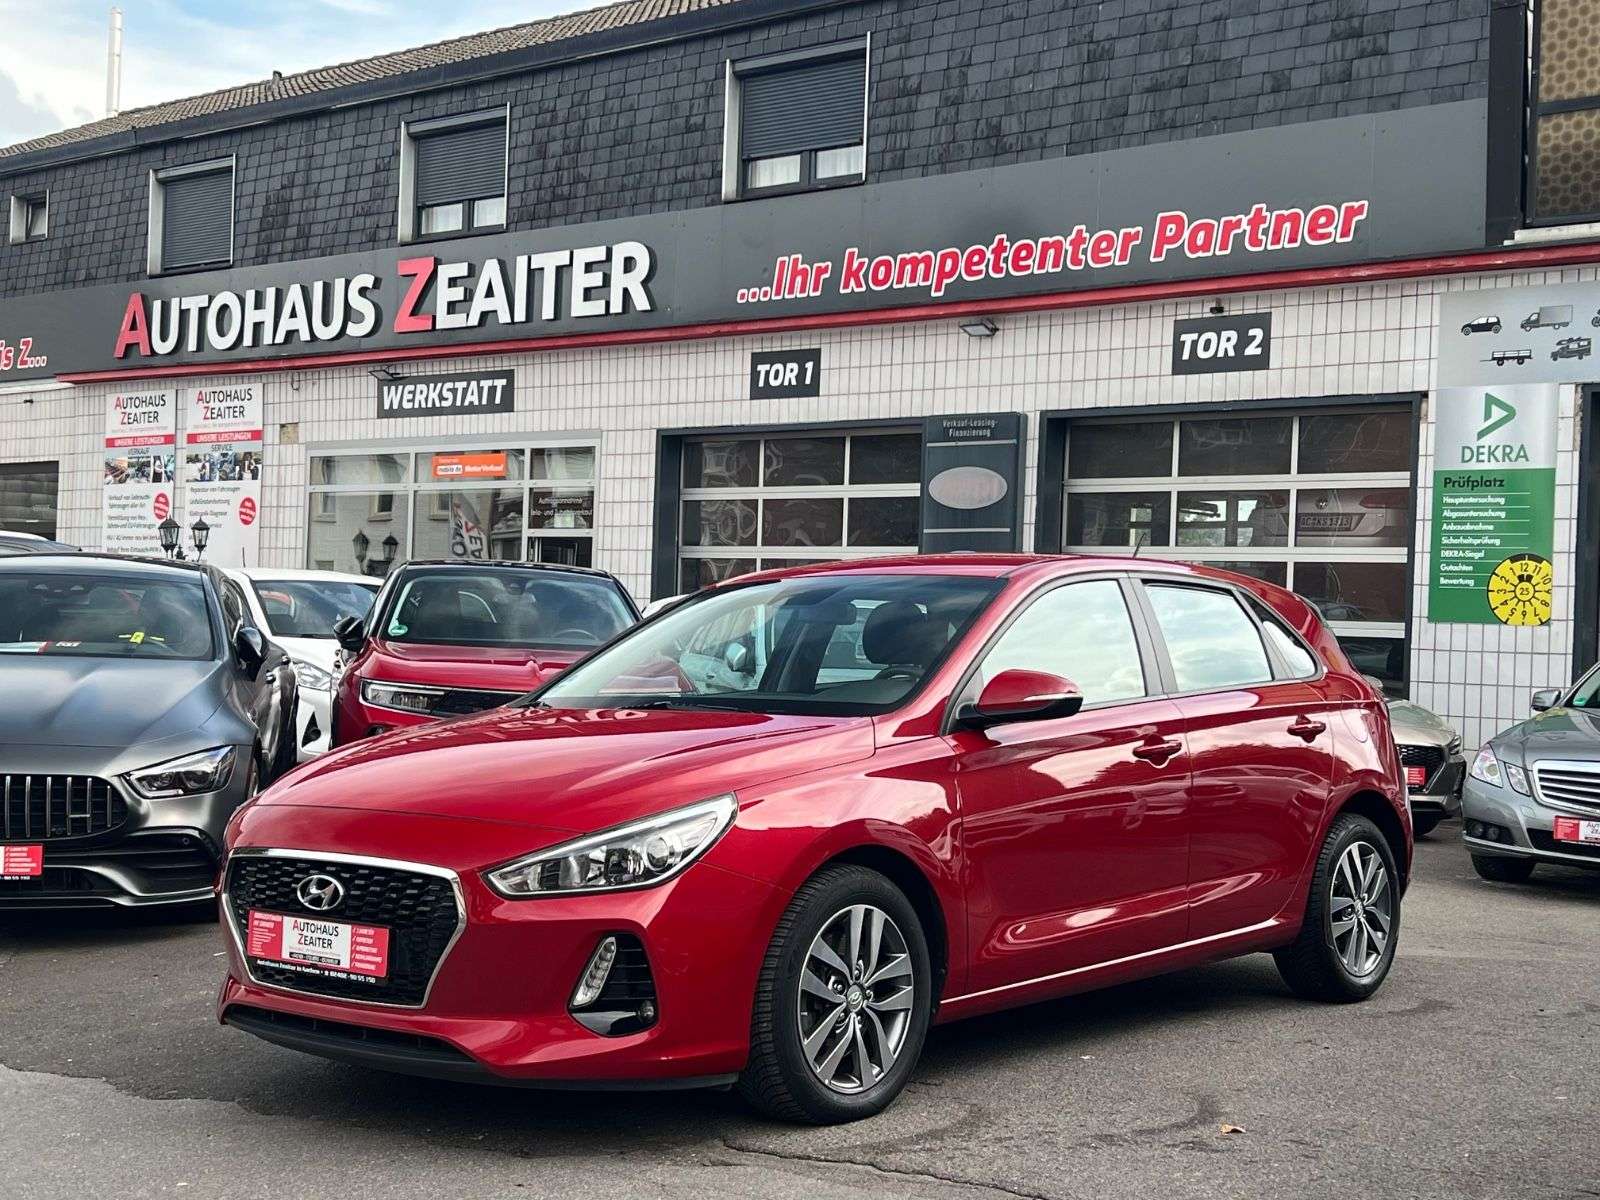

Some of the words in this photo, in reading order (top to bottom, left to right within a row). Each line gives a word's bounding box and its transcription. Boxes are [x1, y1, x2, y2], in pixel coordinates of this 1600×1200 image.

[737, 254, 831, 303] ...Ihr
[839, 224, 1143, 297] kompetenter
[1150, 200, 1368, 263] Partner
[113, 272, 378, 358] AUTOHAUS
[393, 241, 653, 333] ZEAITER
[1180, 330, 1238, 360] TOR
[1244, 328, 1264, 356] 2
[757, 362, 799, 387] TOR
[804, 361, 814, 385] 1
[115, 394, 166, 411] AUTOHAUS
[196, 388, 253, 405] AUTOHAUS
[383, 379, 507, 410] WERKSTATT
[121, 410, 159, 425] ZEAITER
[204, 405, 245, 420] ZEAITER
[196, 433, 217, 443] UNSERE
[218, 431, 252, 441] LEISTUNGEN
[949, 429, 990, 437] Finanzierung
[211, 444, 233, 452] SERVICE
[1461, 444, 1529, 463] DEKRA
[1443, 475, 1505, 491] Prüfplatz
[1442, 495, 1505, 505] Hauptuntersuchung
[1442, 509, 1506, 518] Abgasuntersuchung
[1441, 550, 1484, 559] DEKRA-Siegel
[1440, 563, 1473, 571] Gutachten
[1440, 577, 1474, 586] Bewertung
[293, 920, 339, 937] AUTOHAUS
[298, 933, 333, 949] ZEAITER
